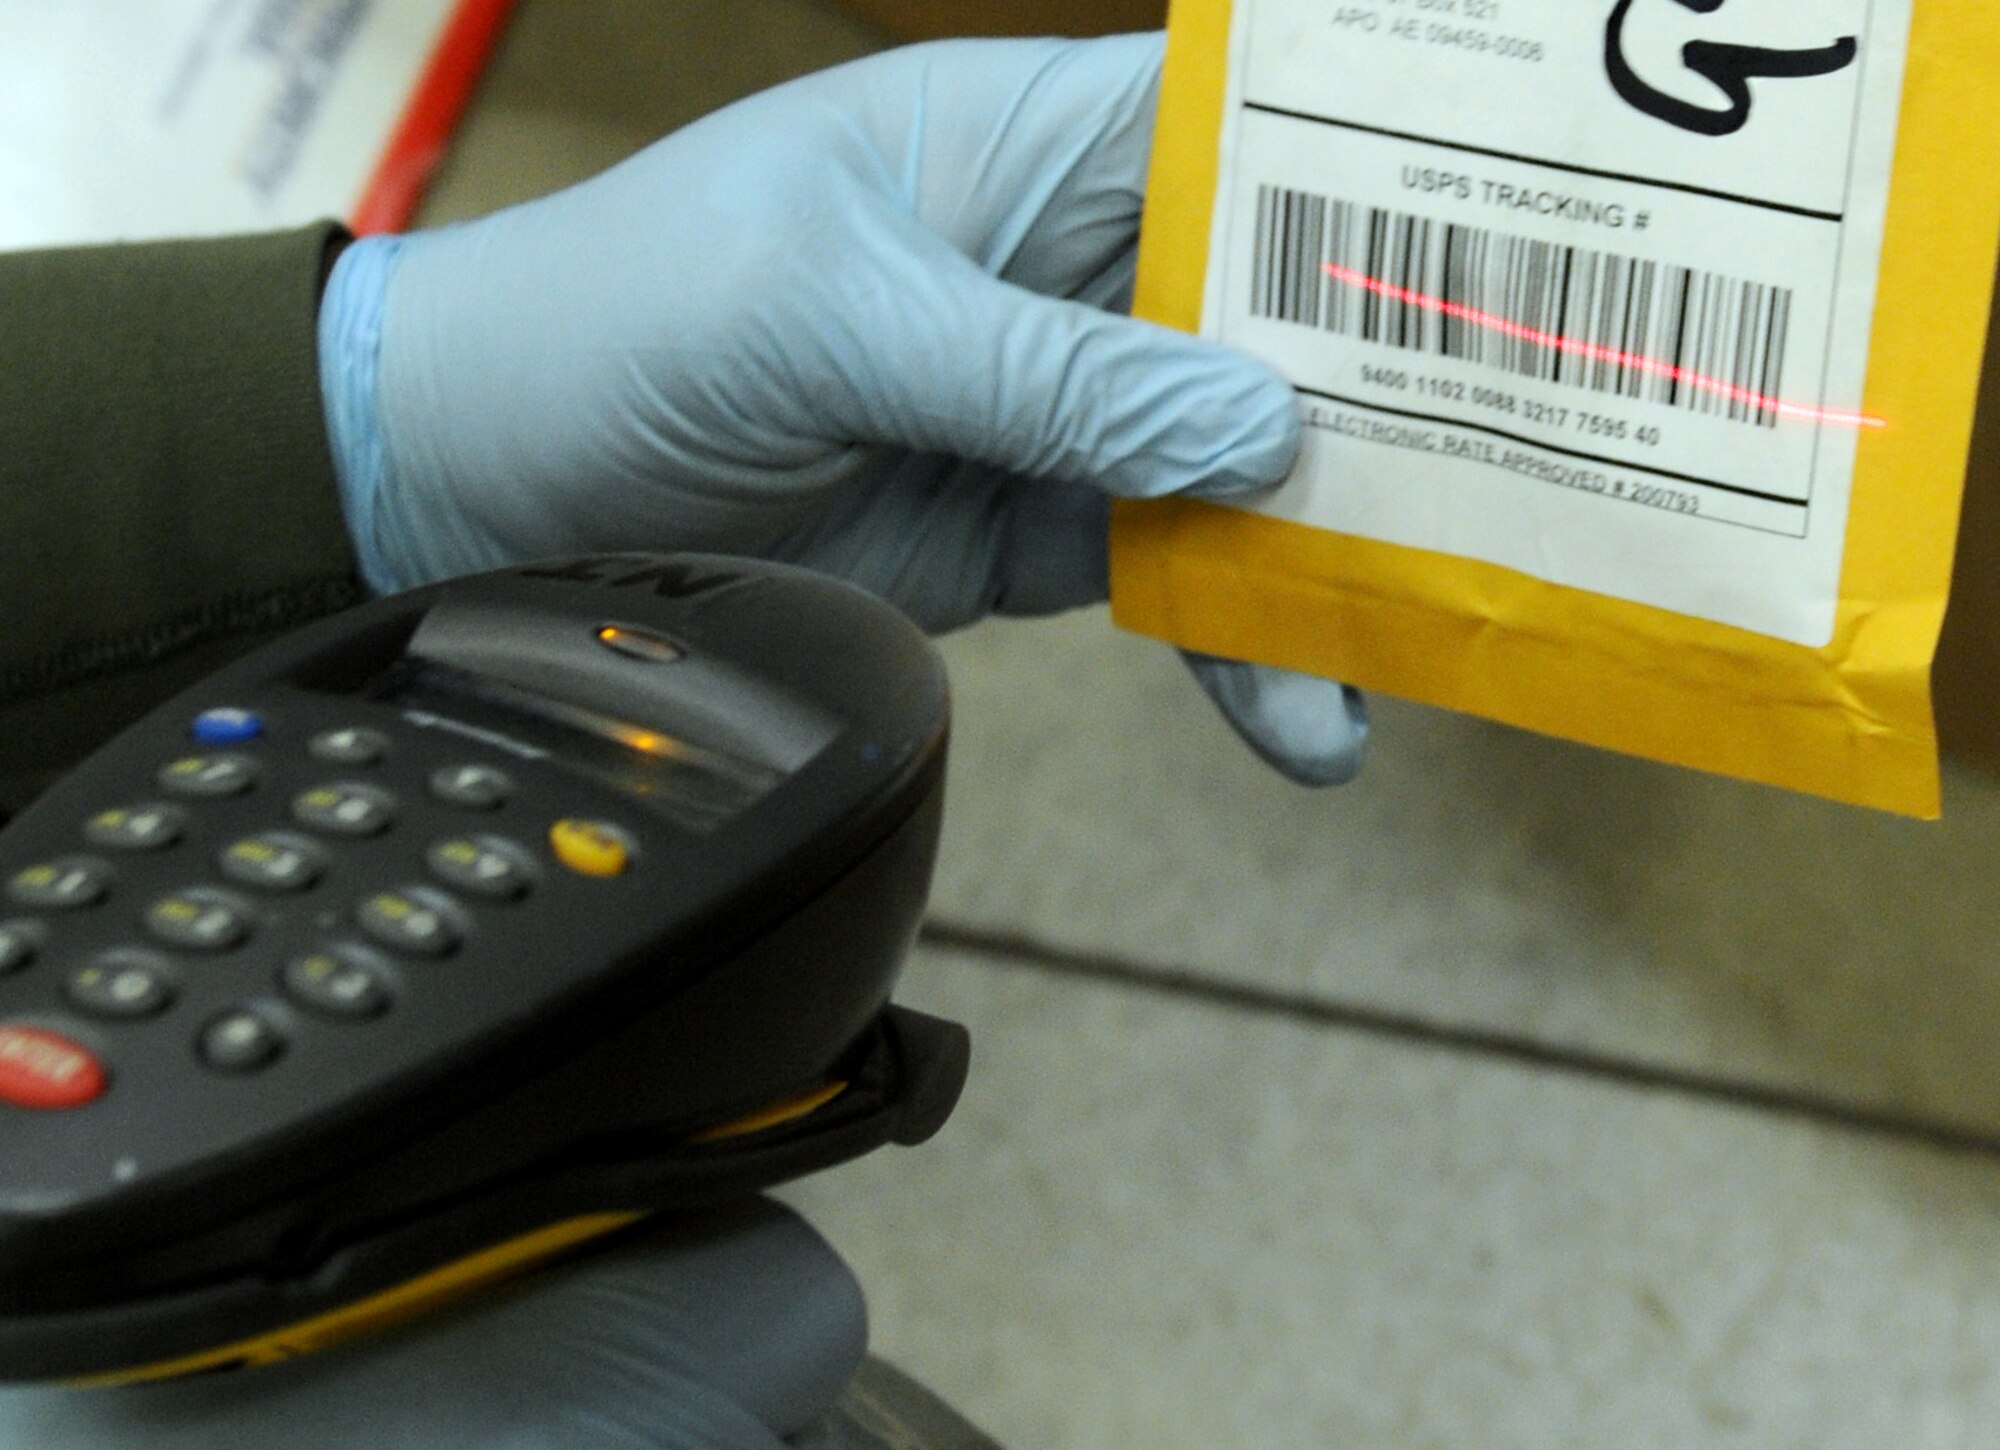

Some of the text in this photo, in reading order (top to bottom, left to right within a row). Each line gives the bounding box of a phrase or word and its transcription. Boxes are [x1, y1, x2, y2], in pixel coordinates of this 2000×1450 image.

[1332, 7, 1379, 33] APO
[1390, 18, 1420, 41] AE
[1401, 165, 1654, 230] USPS TRACKING #
[1361, 364, 1409, 391] 9400
[1415, 376, 1466, 401] 1102
[1522, 400, 1569, 426] 3217
[1577, 412, 1628, 439] 7595
[1634, 424, 1661, 447] 40
[1309, 407, 1701, 515] ELECTRONIC RATE APPROVED # 200793
